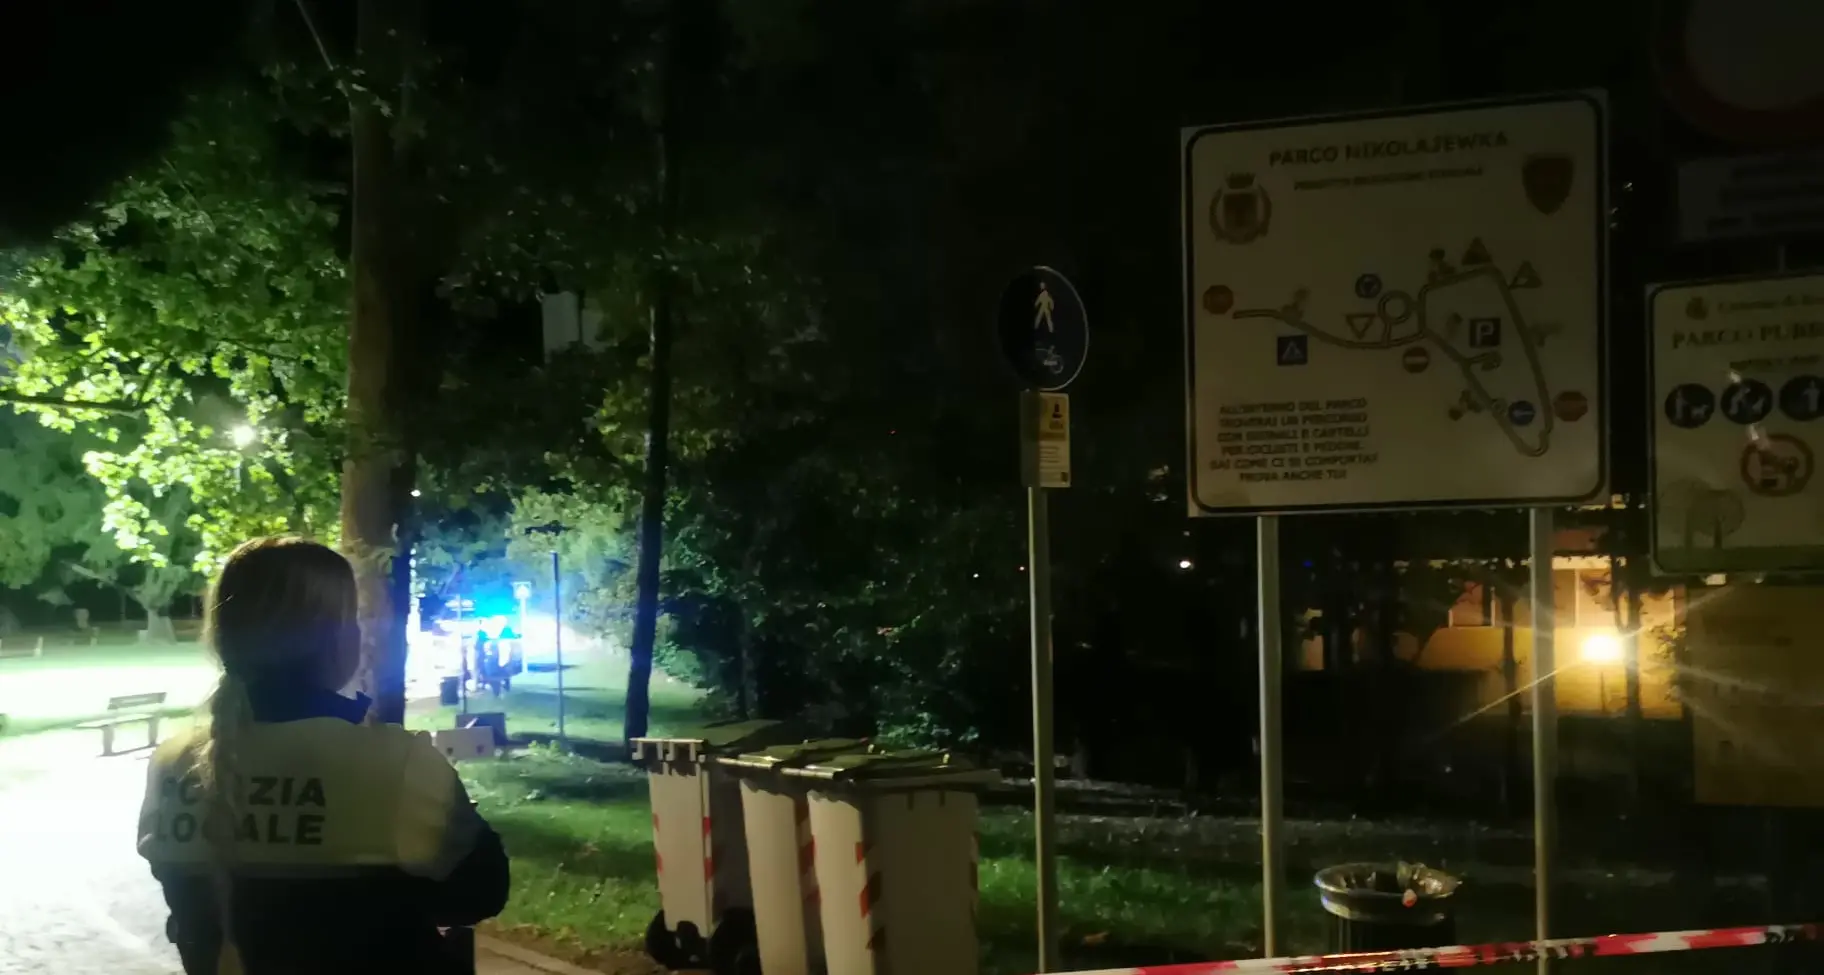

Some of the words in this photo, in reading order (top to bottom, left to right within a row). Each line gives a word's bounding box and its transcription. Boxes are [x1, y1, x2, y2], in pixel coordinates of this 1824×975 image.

[1269, 149, 1339, 168] PARCO
[1345, 130, 1509, 160] NIKOLAJEWKA
[1673, 329, 1753, 348] PARCO
